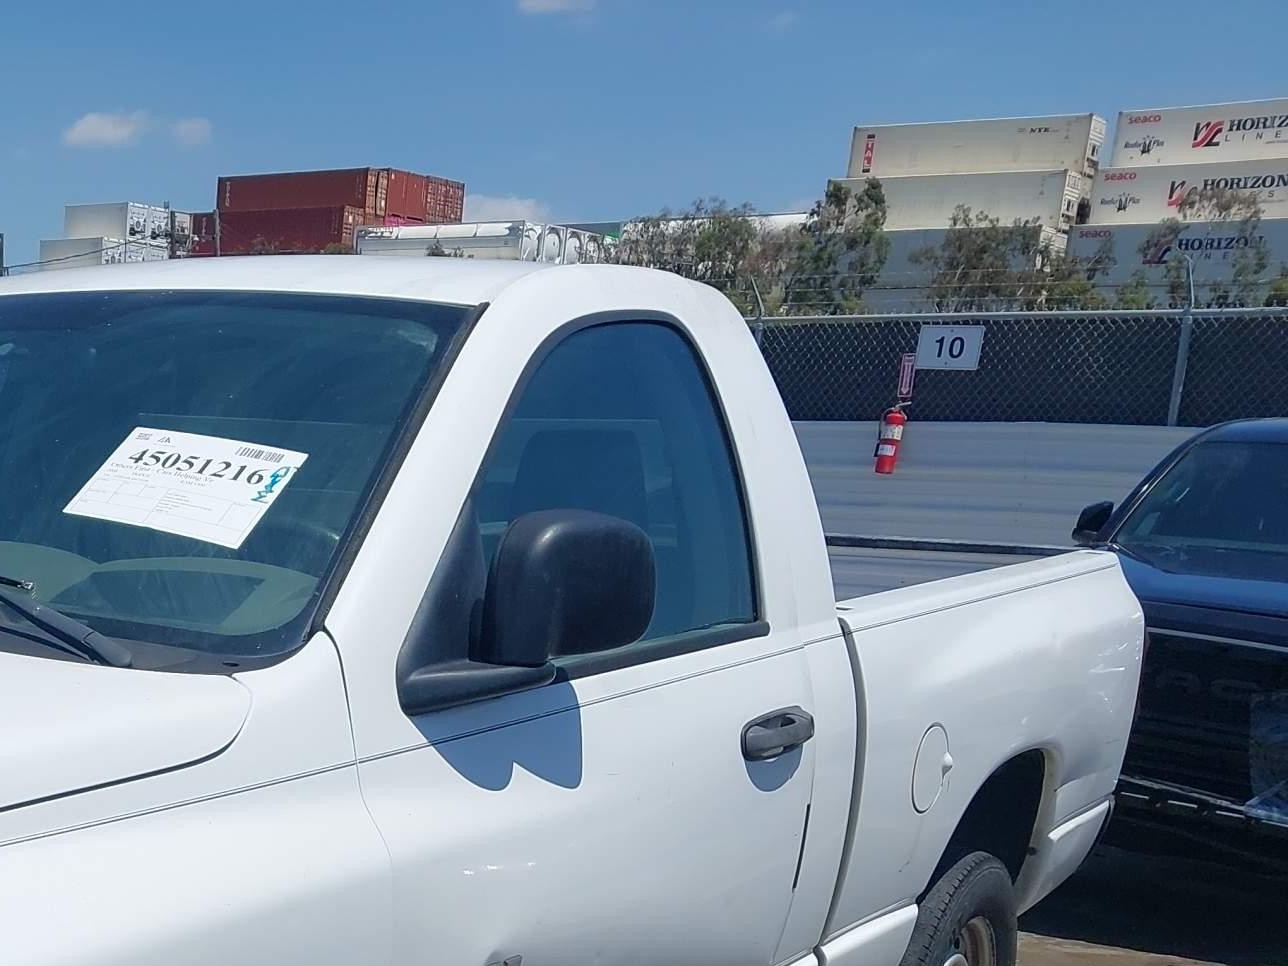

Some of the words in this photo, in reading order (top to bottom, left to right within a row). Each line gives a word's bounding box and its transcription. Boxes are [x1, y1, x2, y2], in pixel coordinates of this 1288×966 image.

[1127, 114, 1162, 125] seaco
[1103, 171, 1137, 182] seaco
[935, 335, 965, 359] 10
[128, 448, 272, 485] 45051216
